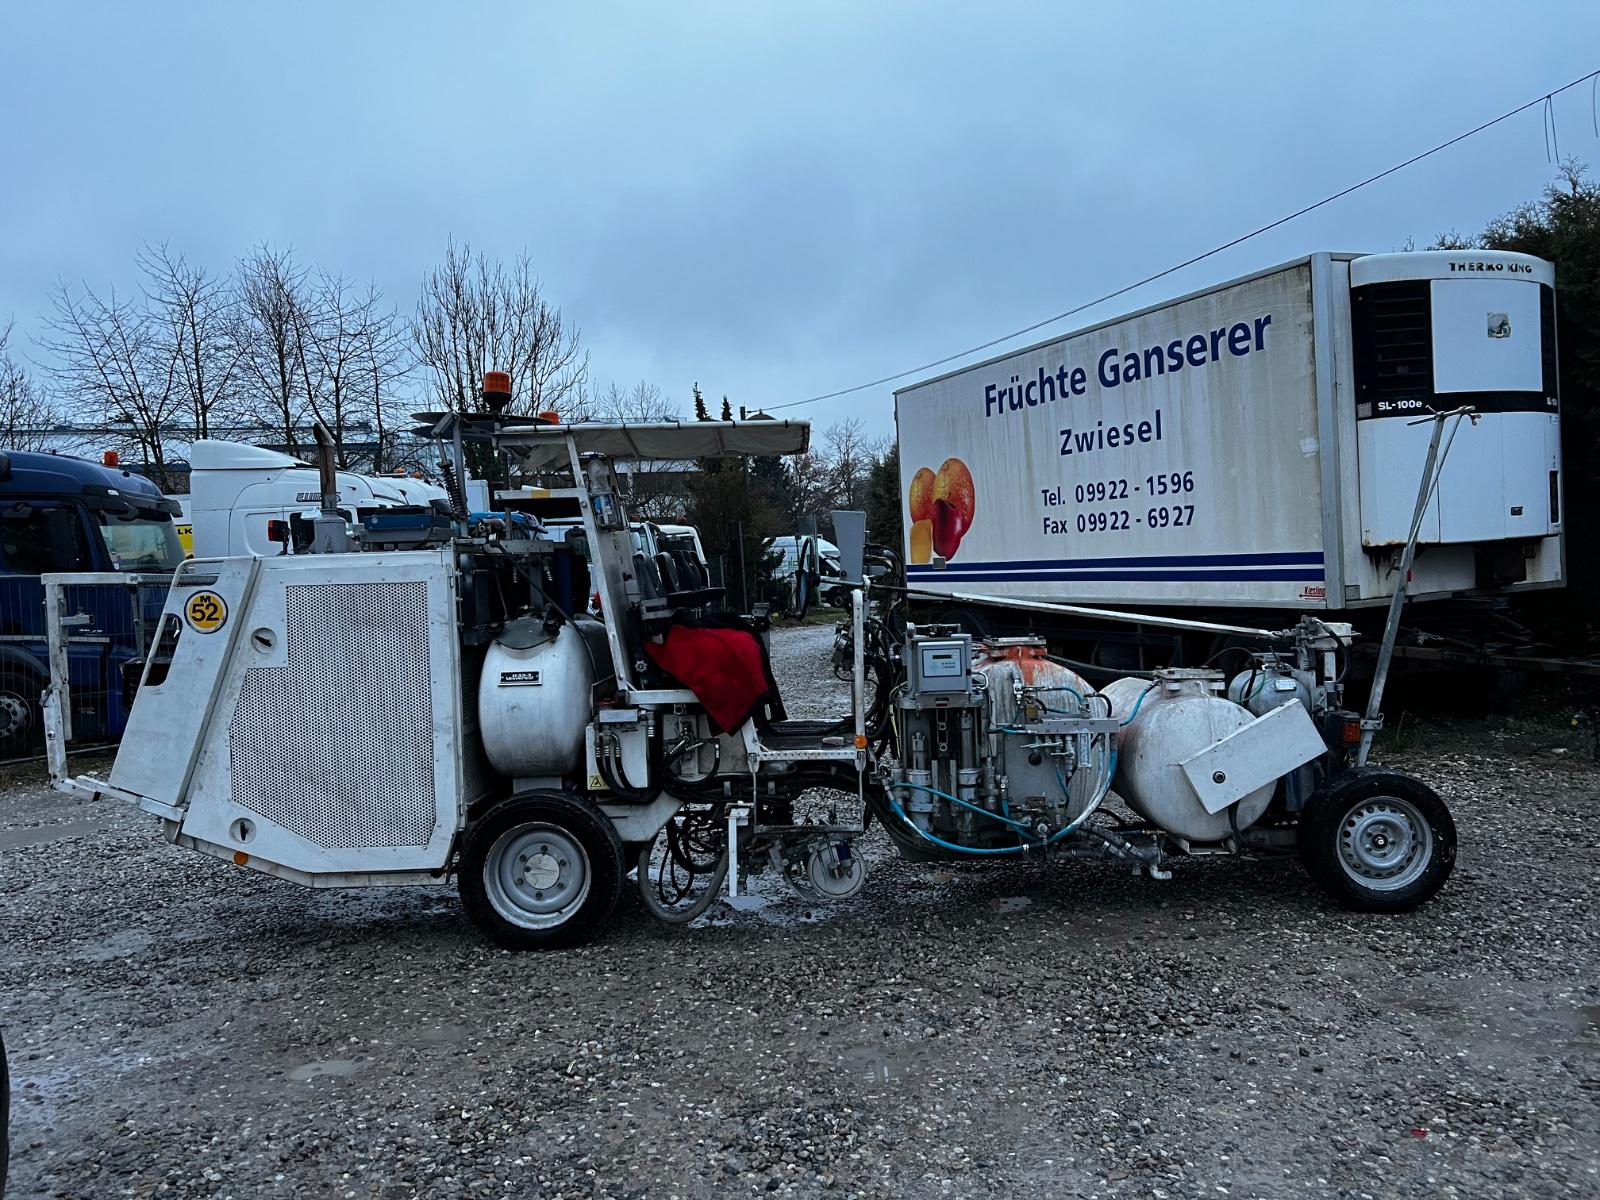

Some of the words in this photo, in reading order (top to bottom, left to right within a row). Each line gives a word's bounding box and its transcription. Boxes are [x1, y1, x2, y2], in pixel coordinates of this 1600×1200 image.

[1448, 262, 1504, 272] THERMO
[1507, 263, 1532, 274] KING
[984, 365, 1087, 418] Früchte
[1097, 314, 1272, 388] Ganserer
[1377, 399, 1423, 411] SL-100e
[1060, 409, 1162, 456] Zwiesel
[1042, 485, 1066, 507] Tel.
[1075, 479, 1129, 504] 09922
[1146, 470, 1194, 496] 1596
[1043, 517, 1068, 535] Fax
[1077, 510, 1130, 533] 09922
[1147, 504, 1195, 529] 6927
[199, 595, 211, 603] M
[191, 603, 220, 622] 52
